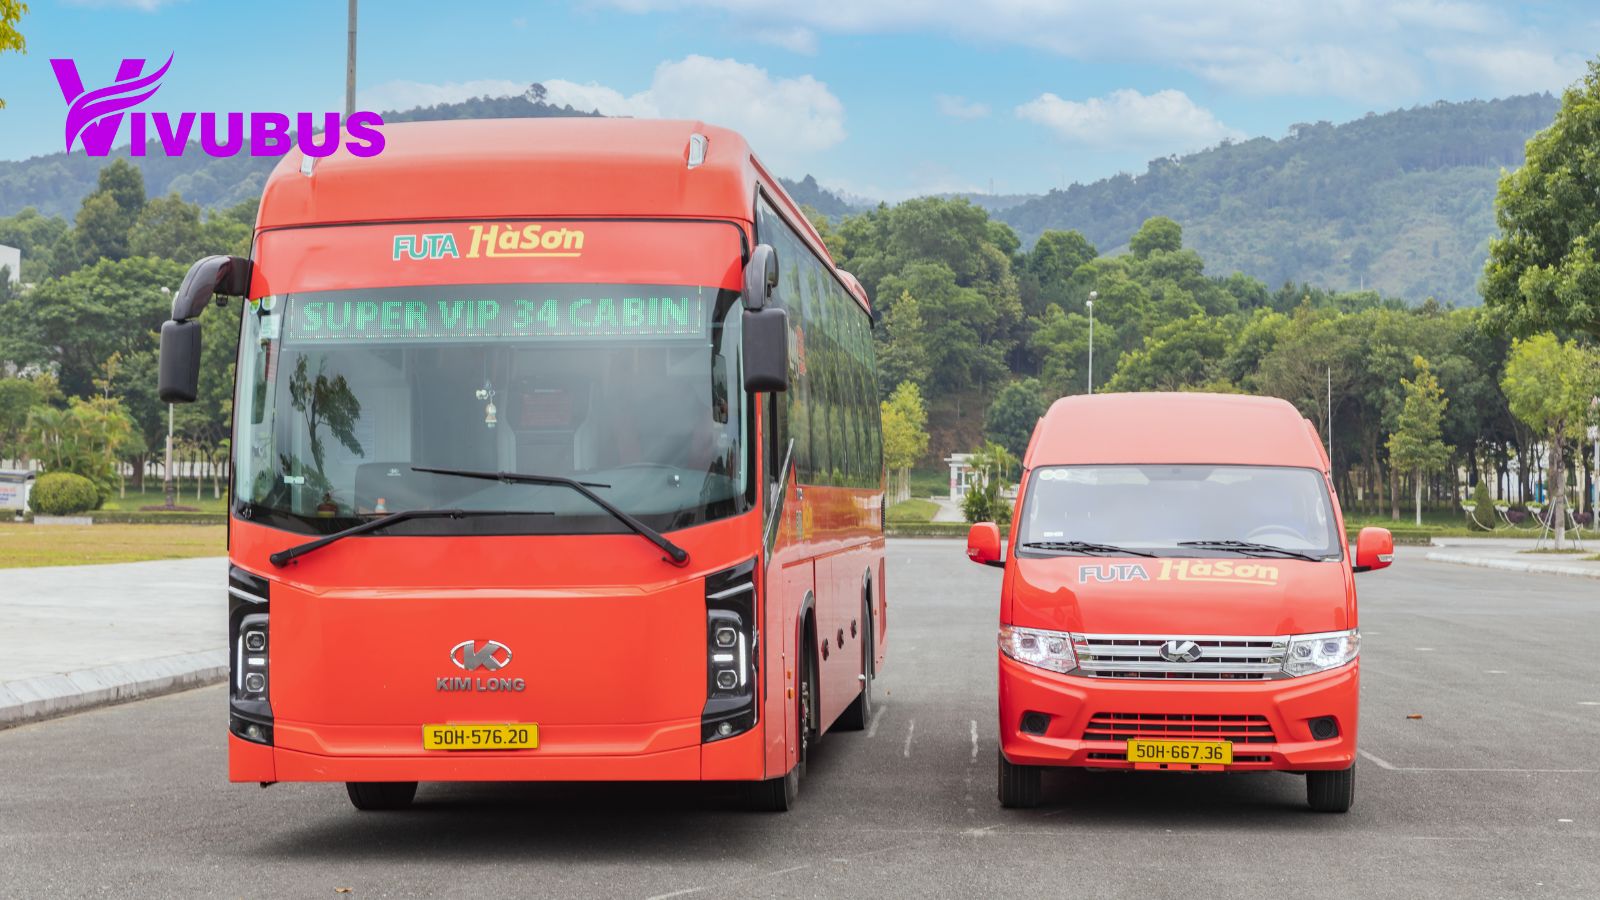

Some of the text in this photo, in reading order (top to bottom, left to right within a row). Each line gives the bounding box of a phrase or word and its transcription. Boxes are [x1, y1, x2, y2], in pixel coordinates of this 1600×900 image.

[393, 233, 460, 261] FUTA
[303, 300, 428, 332] SUPER
[438, 299, 500, 329] VIP
[513, 299, 558, 329] 34
[568, 297, 689, 328] CABIN
[1079, 563, 1151, 584] FUTA
[436, 677, 526, 692] KIM LONG
[433, 729, 529, 745] 50H-576.20
[1136, 744, 1223, 760] 50H-667.36
